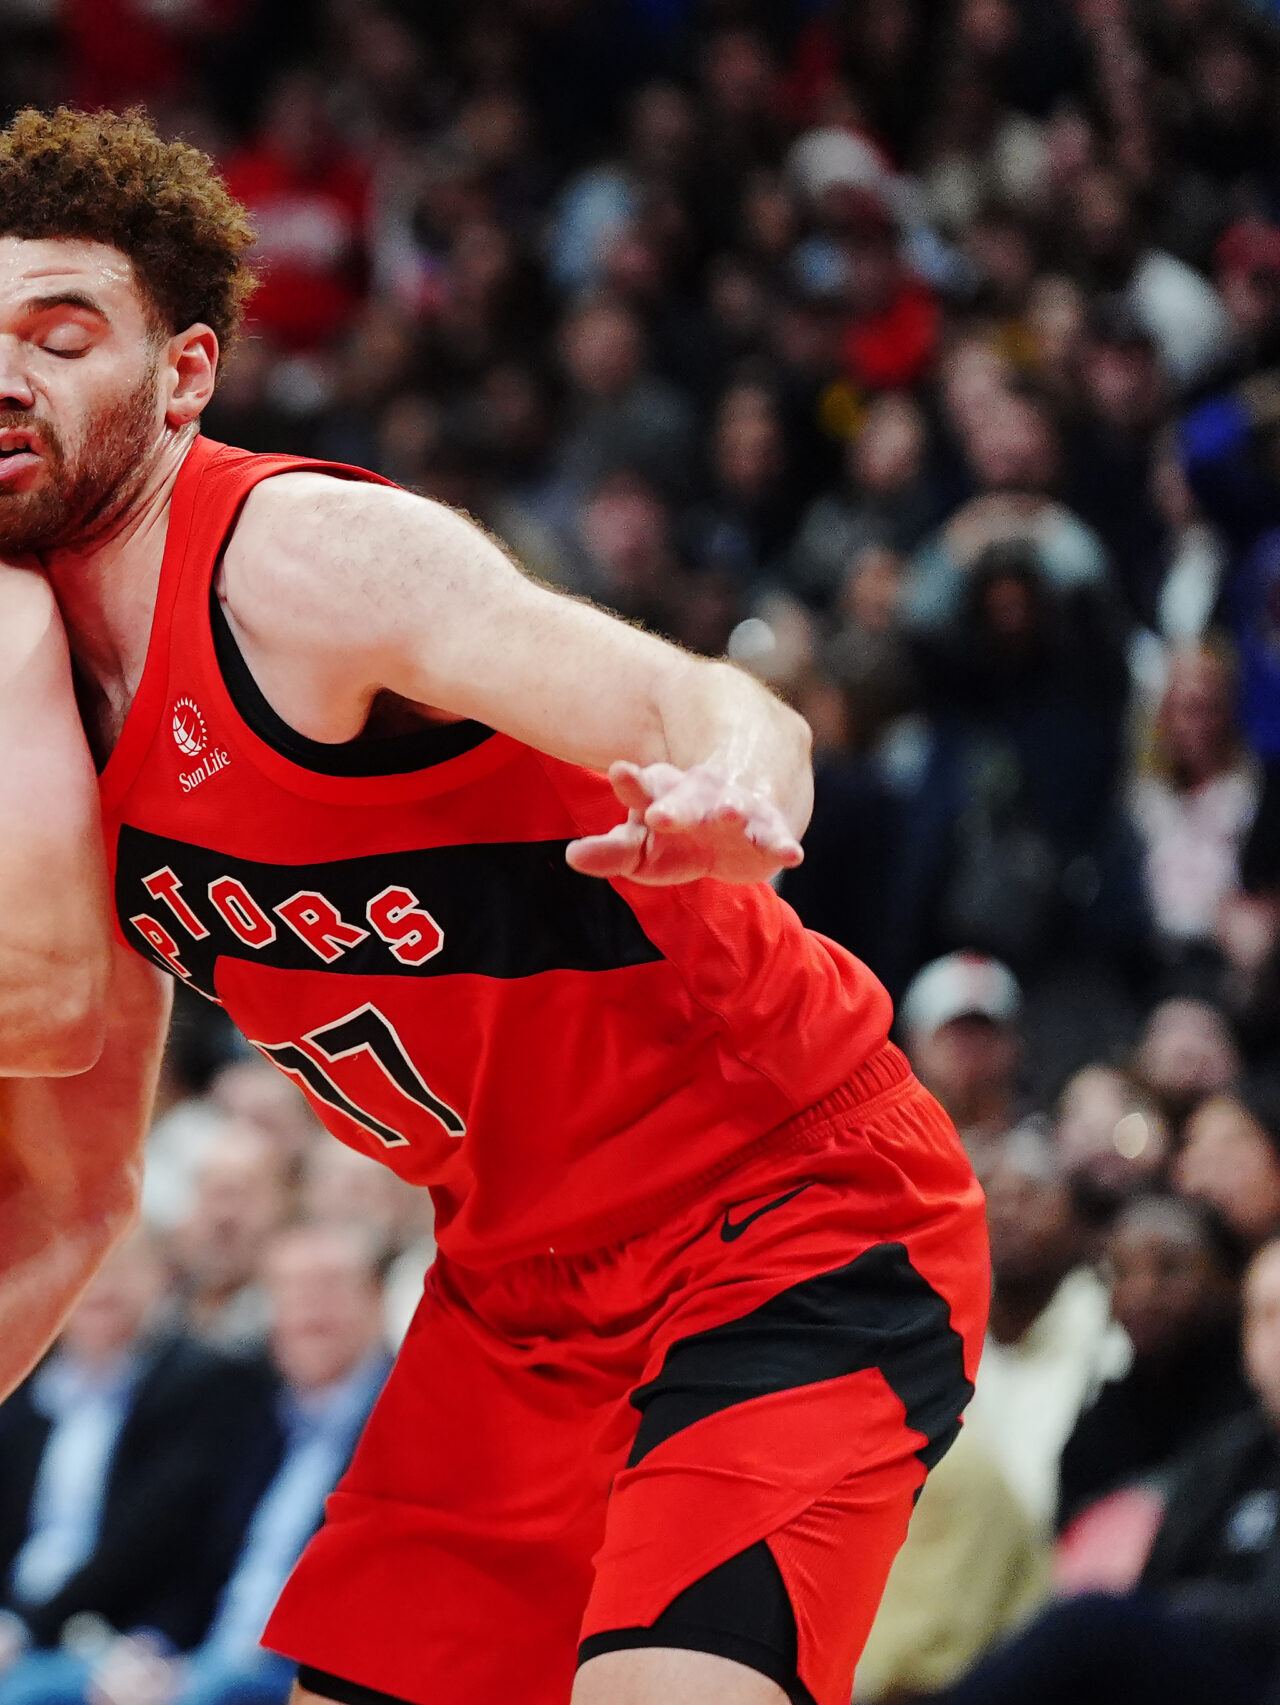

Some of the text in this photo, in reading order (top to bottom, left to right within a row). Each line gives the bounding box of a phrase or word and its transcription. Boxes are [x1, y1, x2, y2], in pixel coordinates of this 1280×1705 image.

[178, 747, 232, 793] Sun Life
[129, 866, 445, 982] PTORS
[248, 1002, 467, 1149] 77
